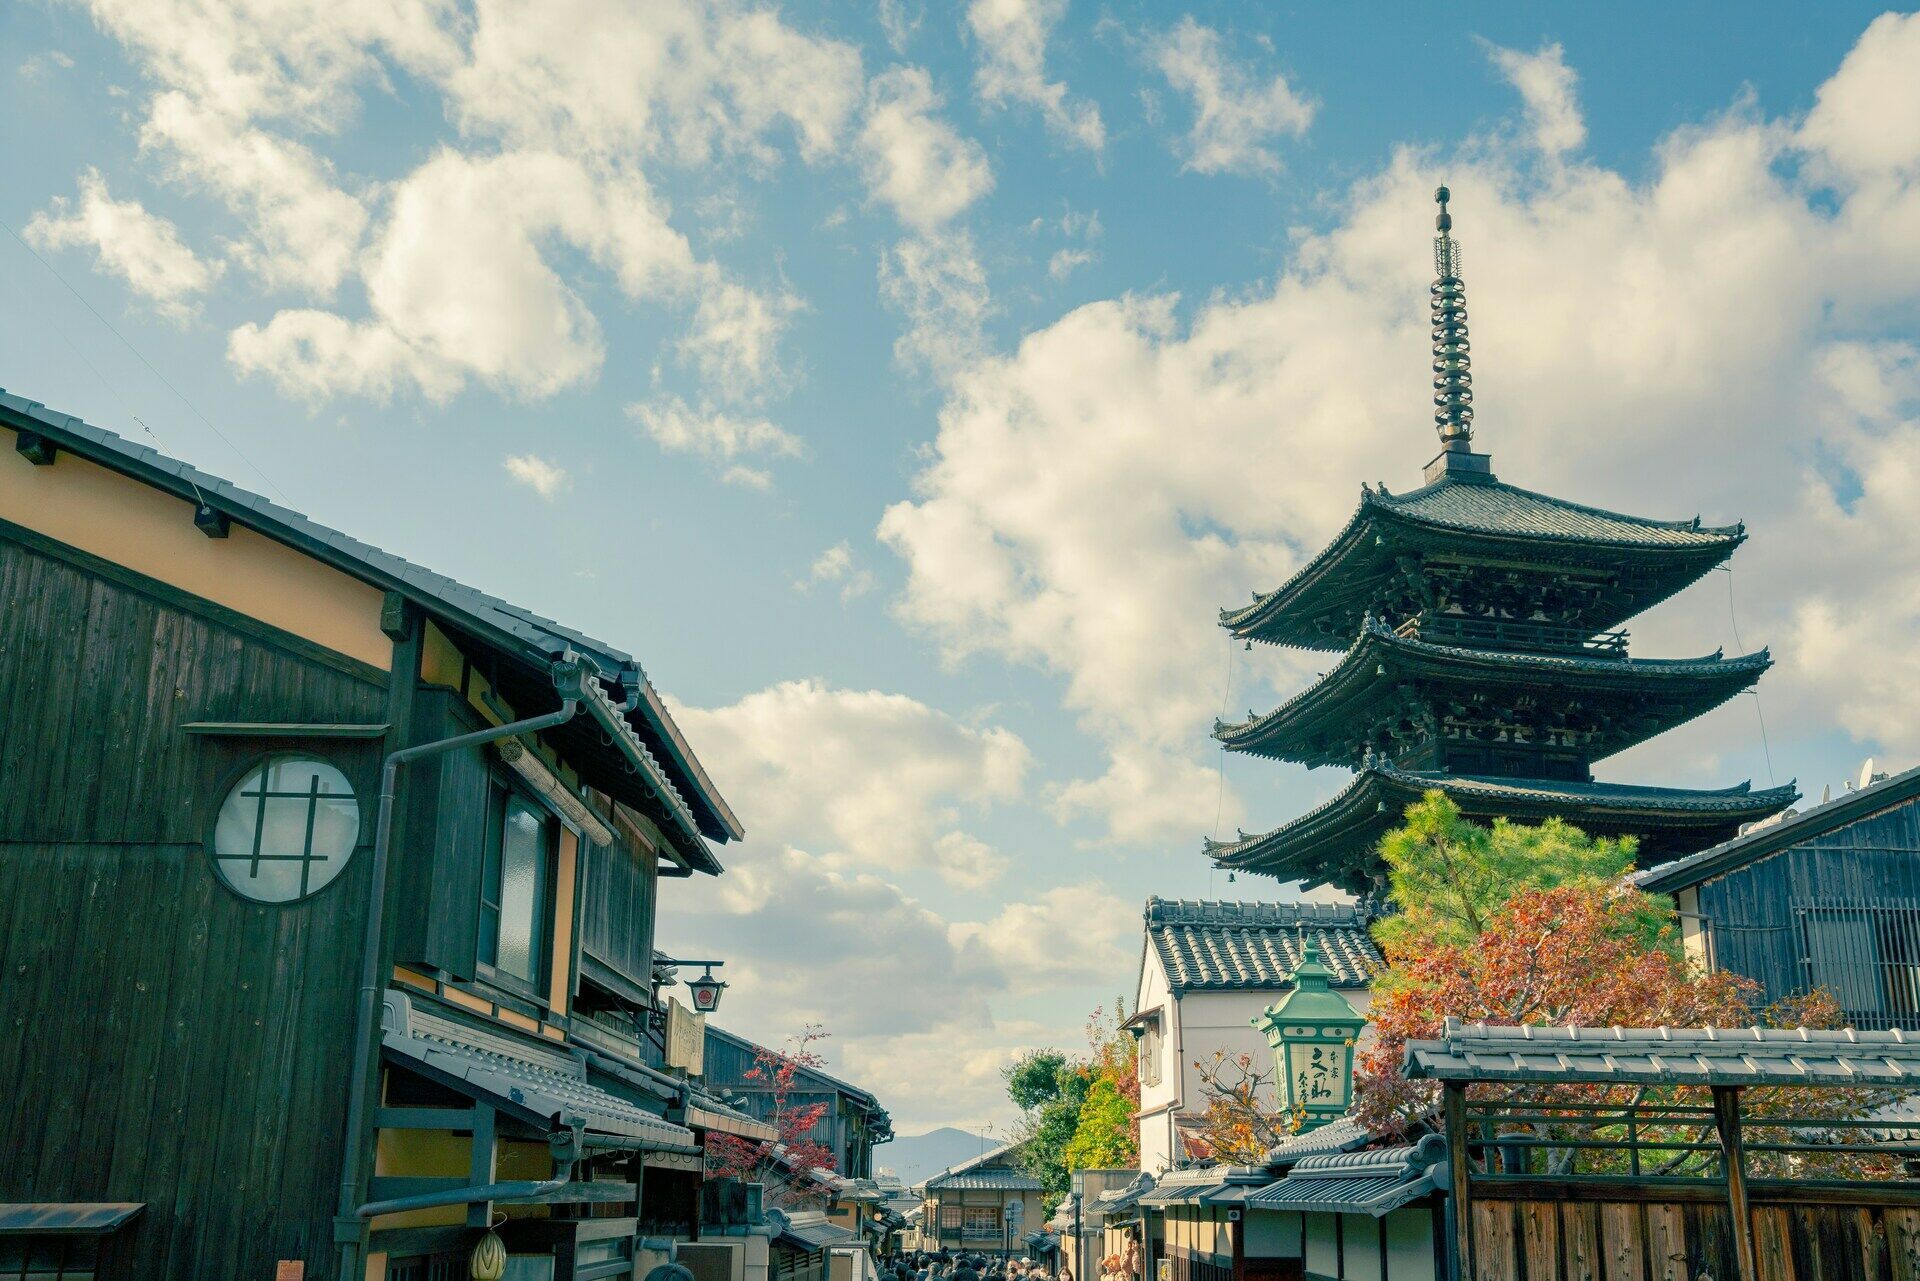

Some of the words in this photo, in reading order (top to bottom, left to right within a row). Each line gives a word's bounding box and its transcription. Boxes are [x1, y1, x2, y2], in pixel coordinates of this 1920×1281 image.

[1298, 1071, 1309, 1103] 茶屋
[1311, 1047, 1332, 1099] 文の助
